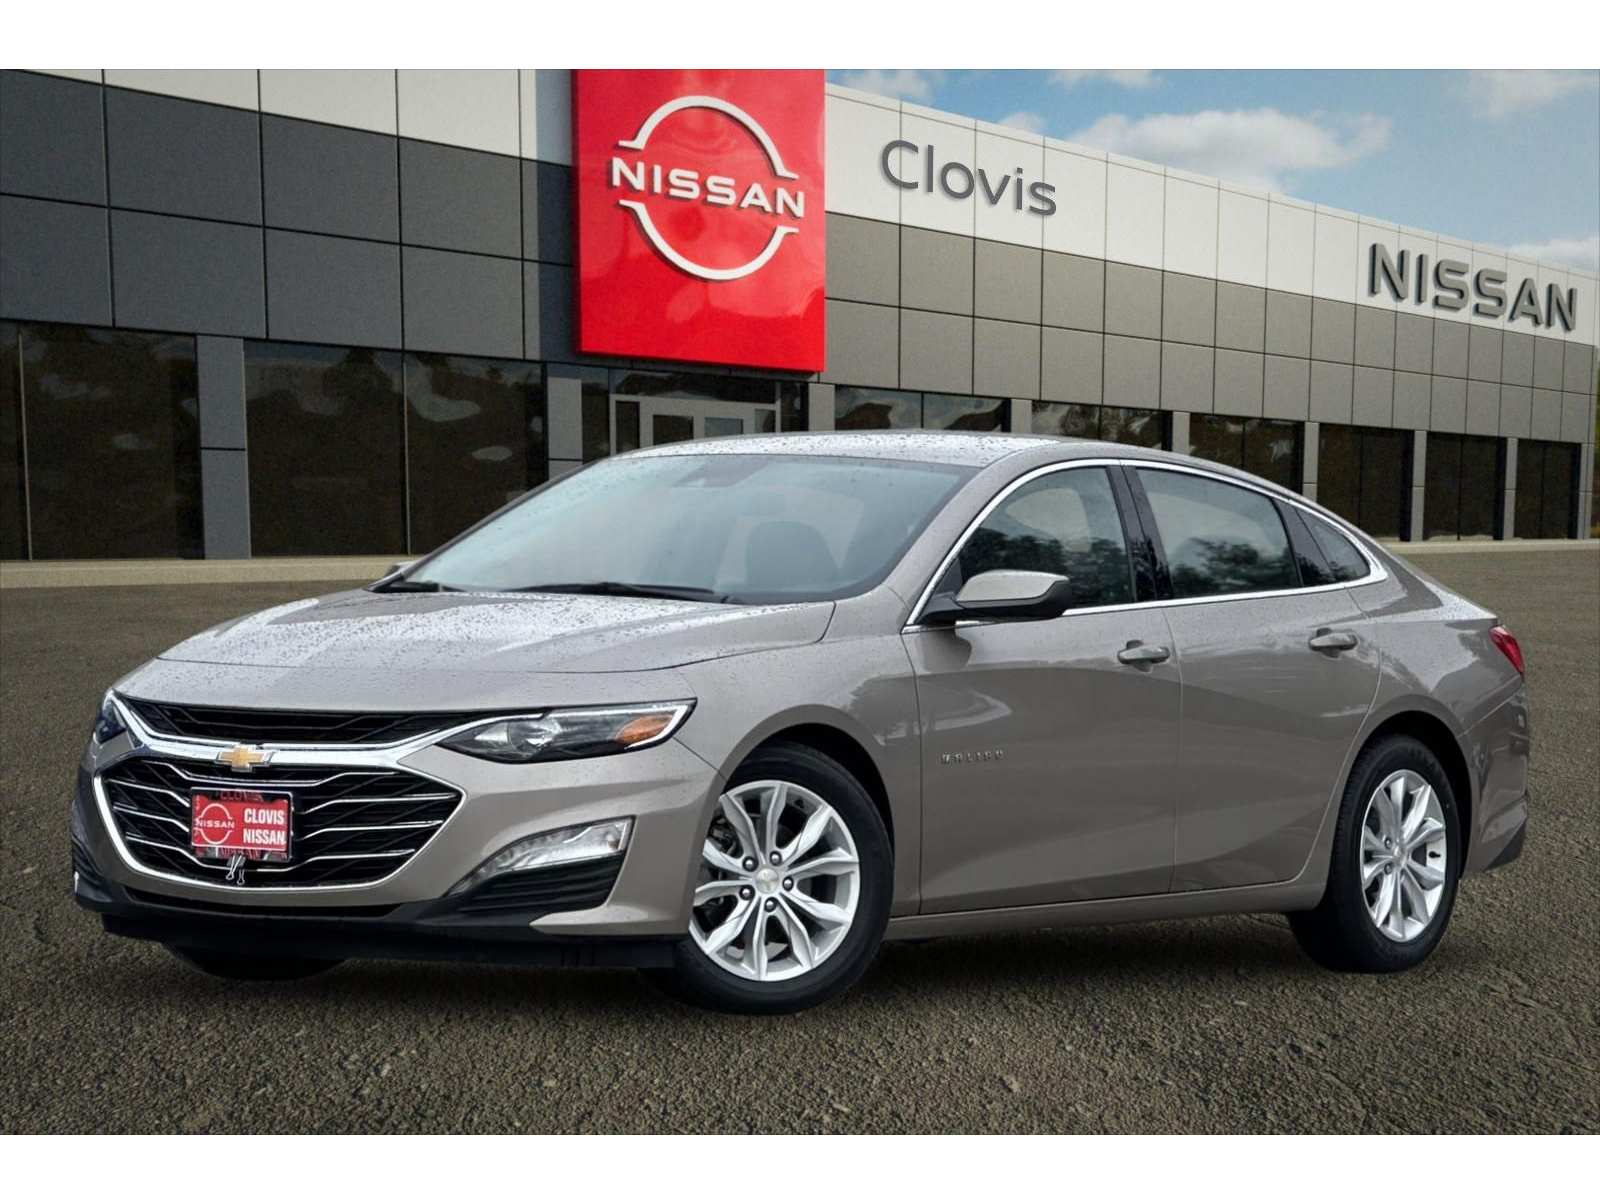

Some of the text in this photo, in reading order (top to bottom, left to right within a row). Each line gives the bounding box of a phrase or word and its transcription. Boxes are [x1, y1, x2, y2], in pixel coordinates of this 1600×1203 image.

[611, 157, 804, 218] NISSAN
[882, 140, 1057, 216] Clovis
[1369, 243, 1577, 332] NISSAN
[195, 818, 235, 828] NISSAN
[244, 808, 285, 825] CLOVIS
[243, 829, 287, 845] NISSAN
